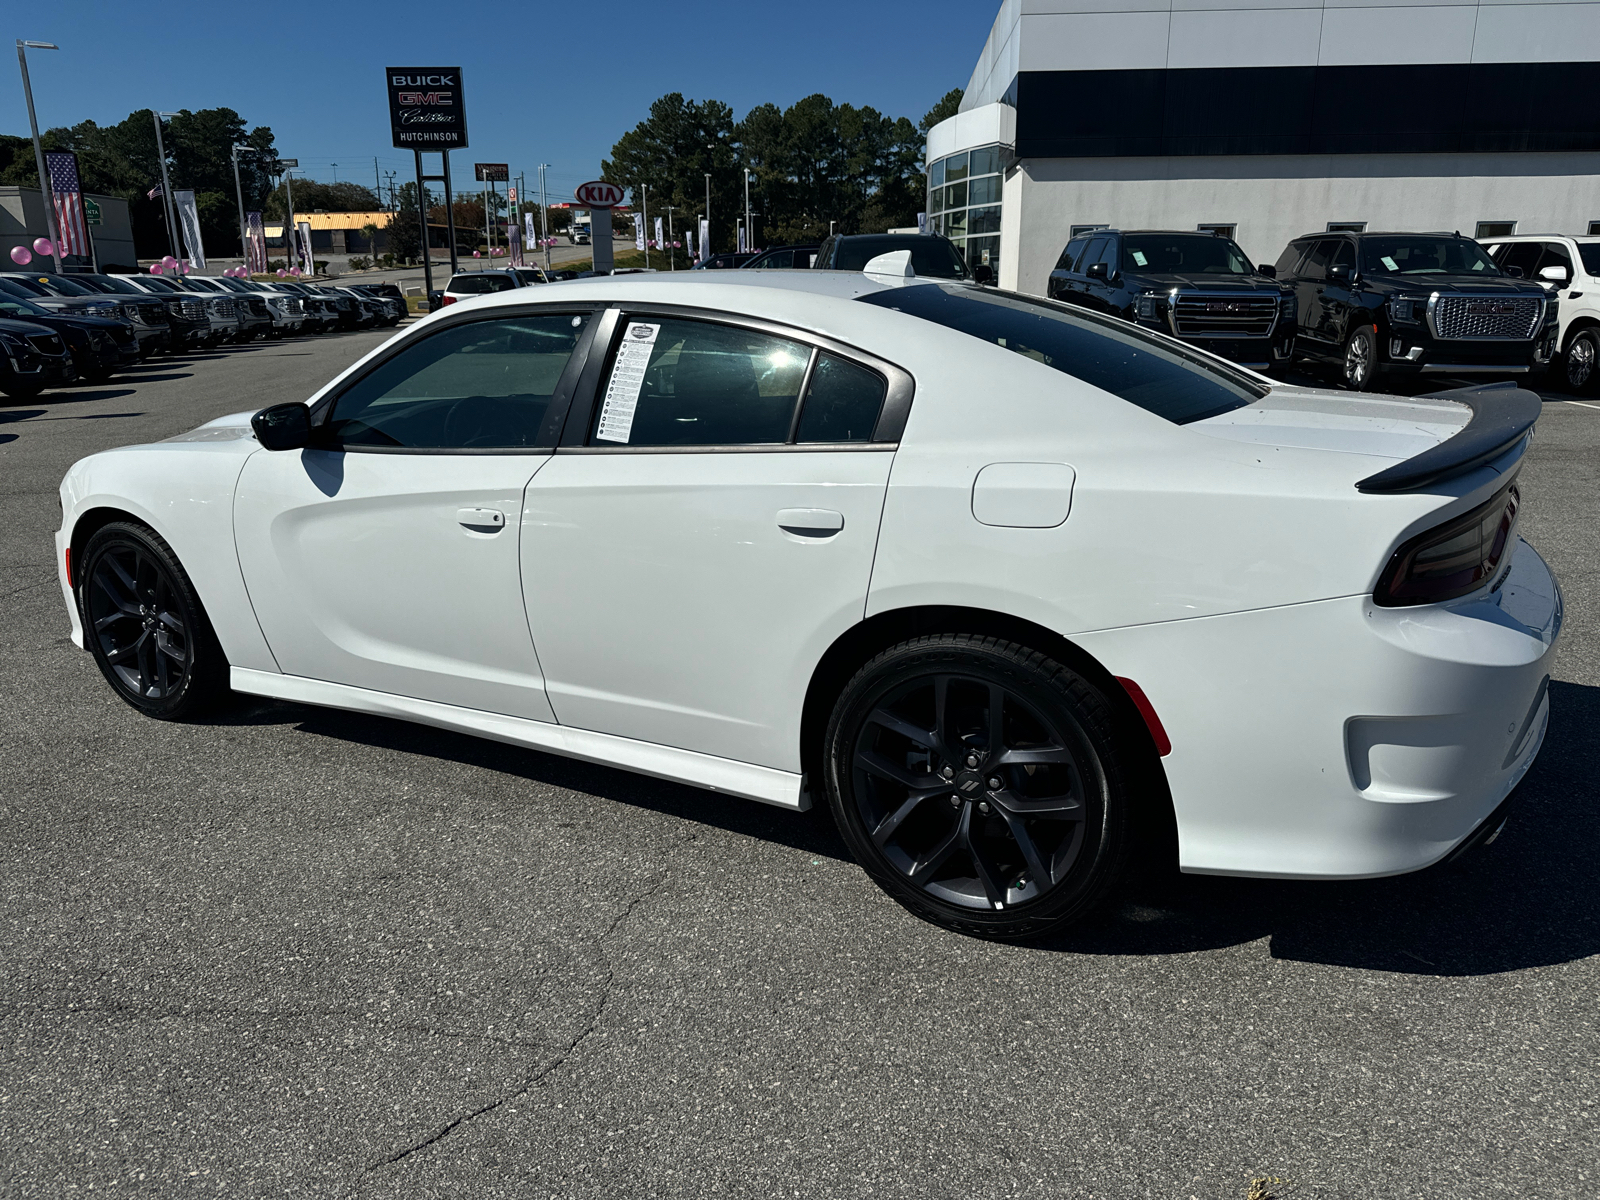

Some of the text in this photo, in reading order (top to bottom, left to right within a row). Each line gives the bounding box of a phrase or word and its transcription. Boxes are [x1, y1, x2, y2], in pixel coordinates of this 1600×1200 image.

[392, 75, 455, 86] BUICK
[398, 91, 453, 106] GMC
[398, 108, 456, 126] Cadillac
[400, 132, 458, 141] HUTCHINSON
[584, 186, 618, 202] KIA
[1206, 302, 1250, 312] GMC
[1469, 303, 1515, 314] GMC
